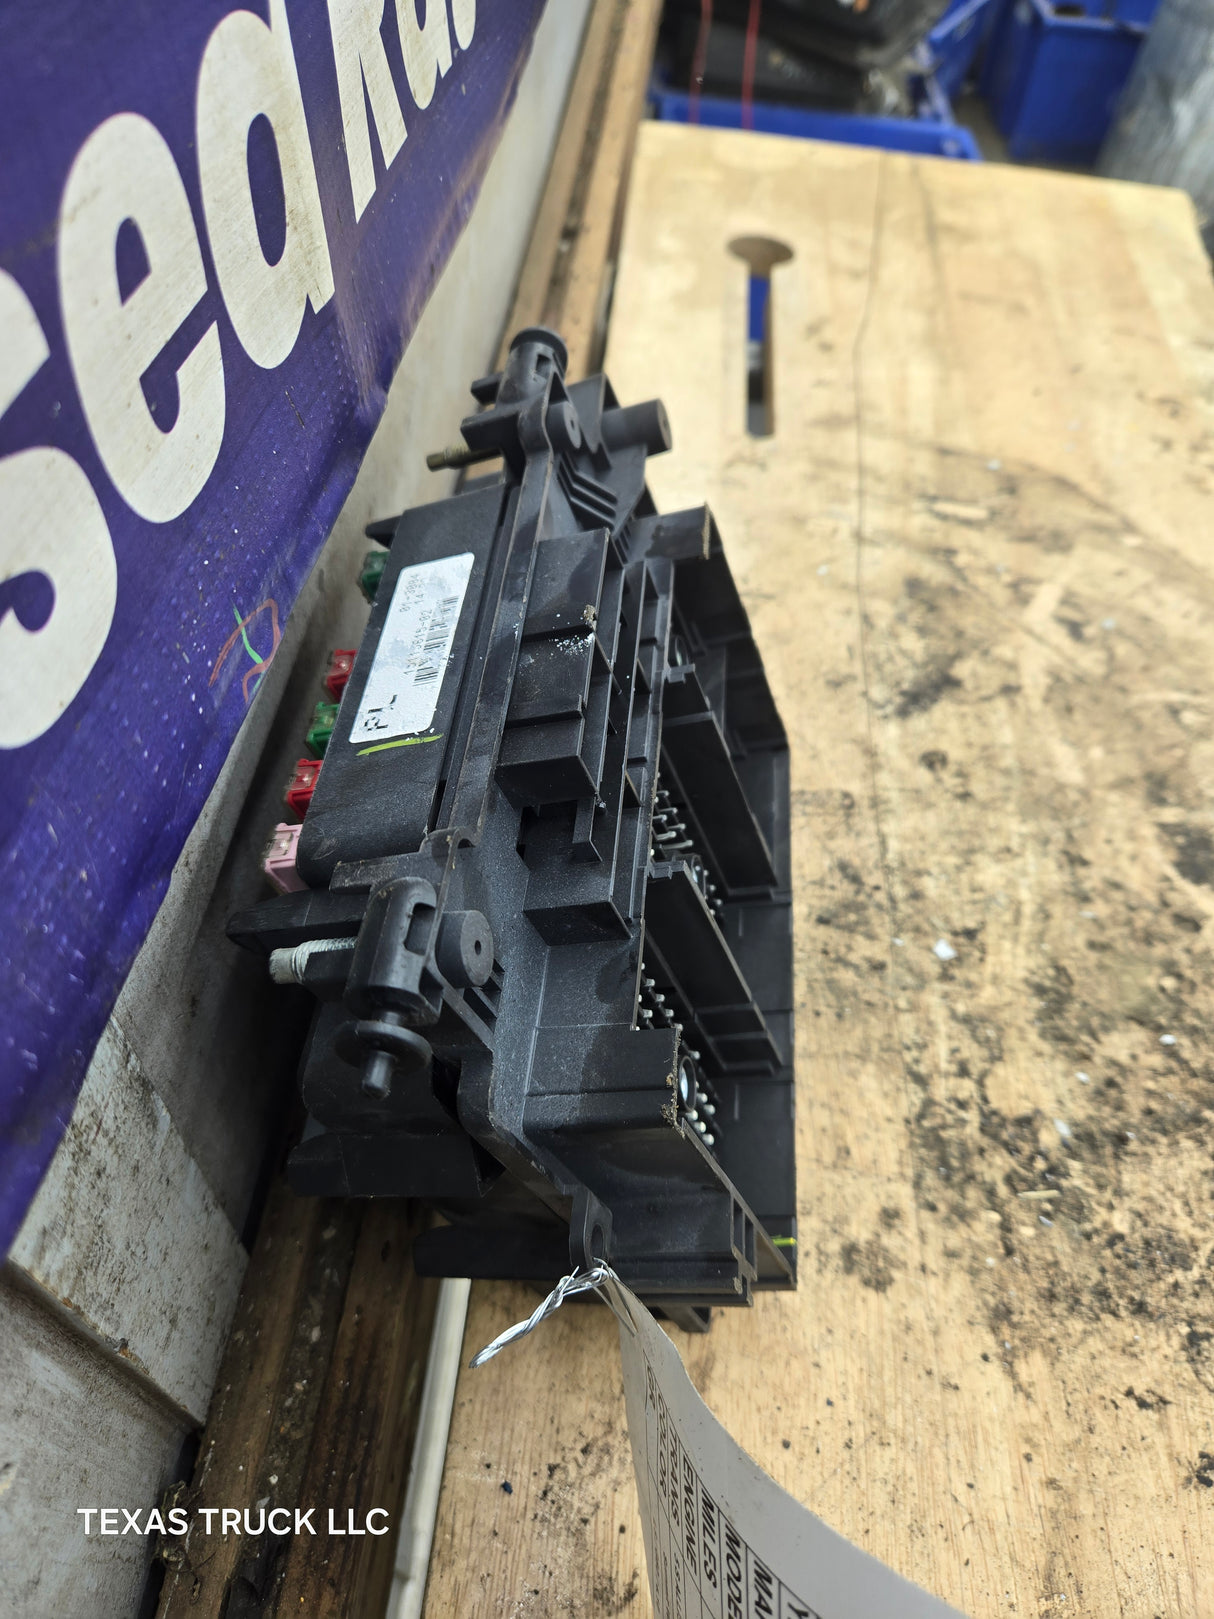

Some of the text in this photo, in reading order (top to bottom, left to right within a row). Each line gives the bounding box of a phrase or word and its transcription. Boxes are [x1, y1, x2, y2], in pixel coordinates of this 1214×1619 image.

[658, 1392, 667, 1499] COLOR
[670, 1427, 680, 1527] TRANS
[683, 1455, 697, 1576] ENGINE
[701, 1487, 717, 1588] MILES
